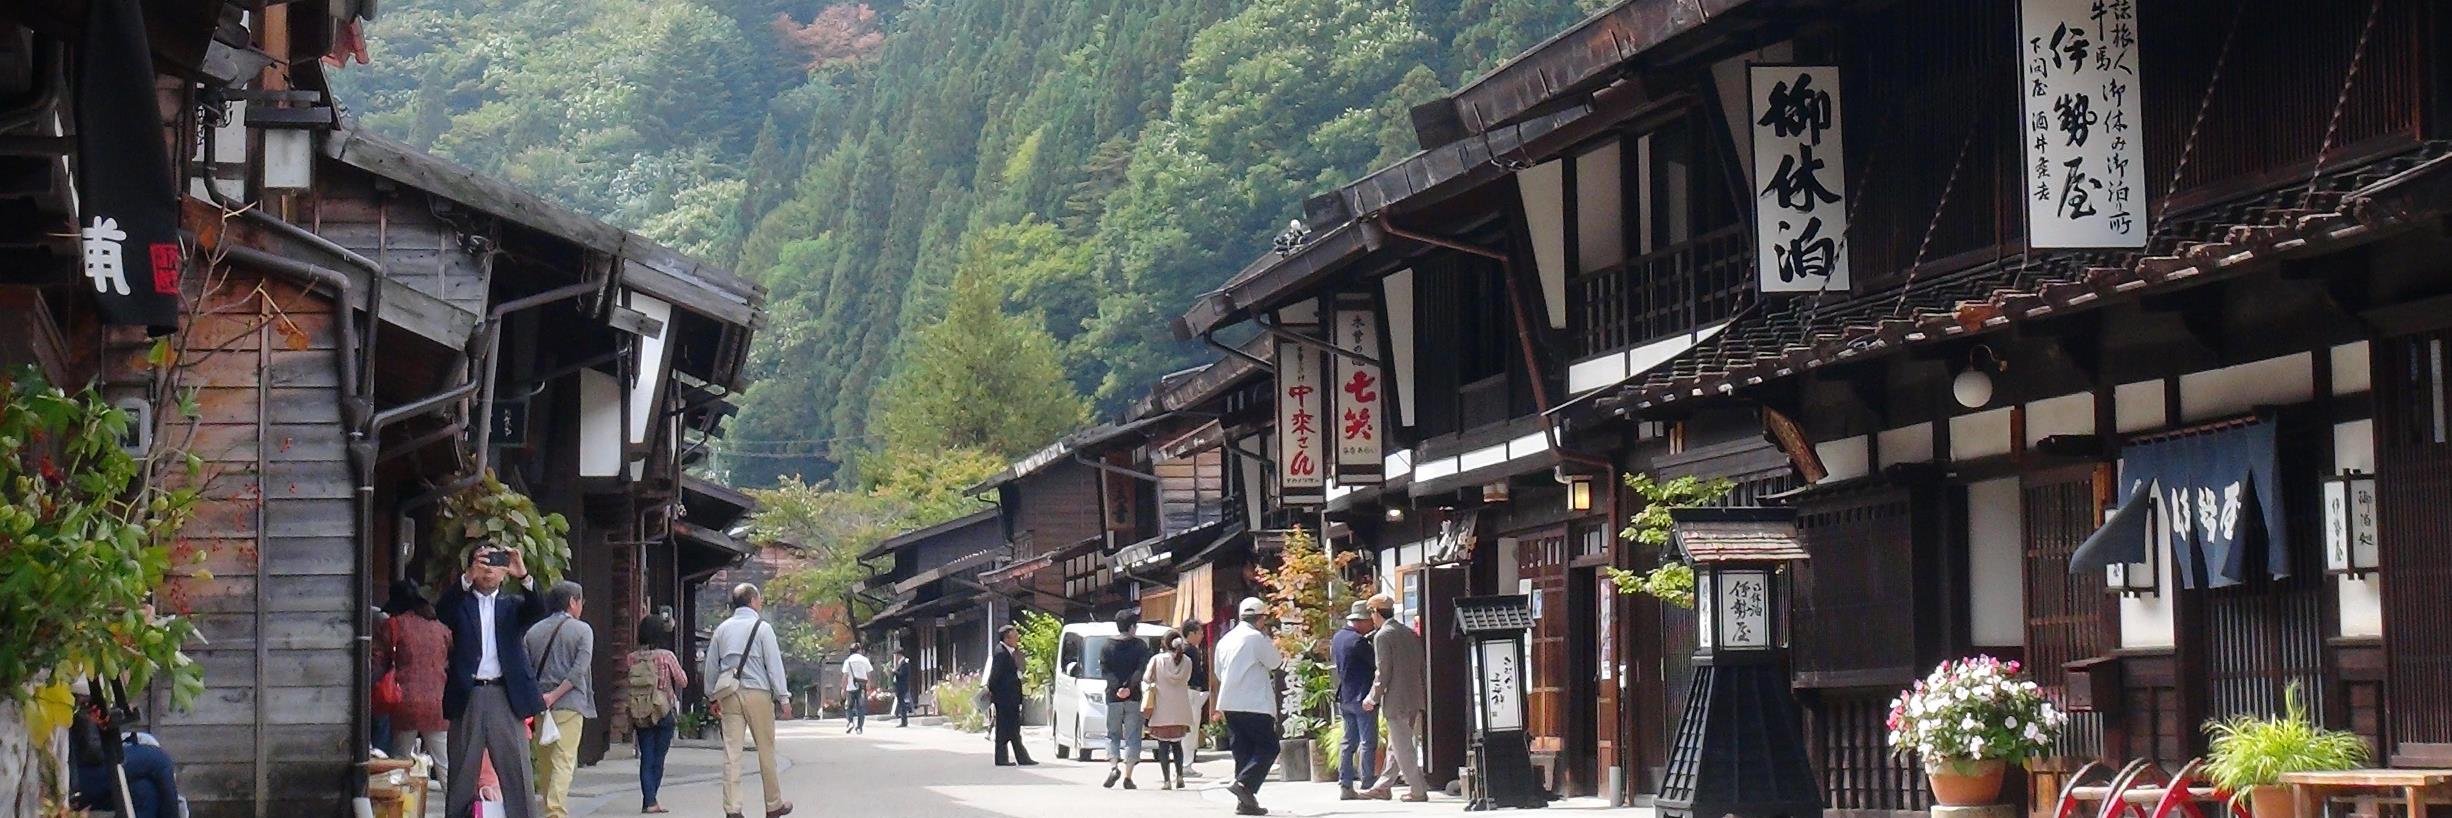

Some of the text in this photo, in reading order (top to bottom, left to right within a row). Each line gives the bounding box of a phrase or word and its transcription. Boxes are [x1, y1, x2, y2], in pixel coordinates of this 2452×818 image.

[1756, 72, 1843, 284] 御休泊
[2048, 21, 2103, 220] 伊勢屋
[1344, 370, 1377, 440] 七笑
[1728, 581, 1752, 642] 伊勢屋
